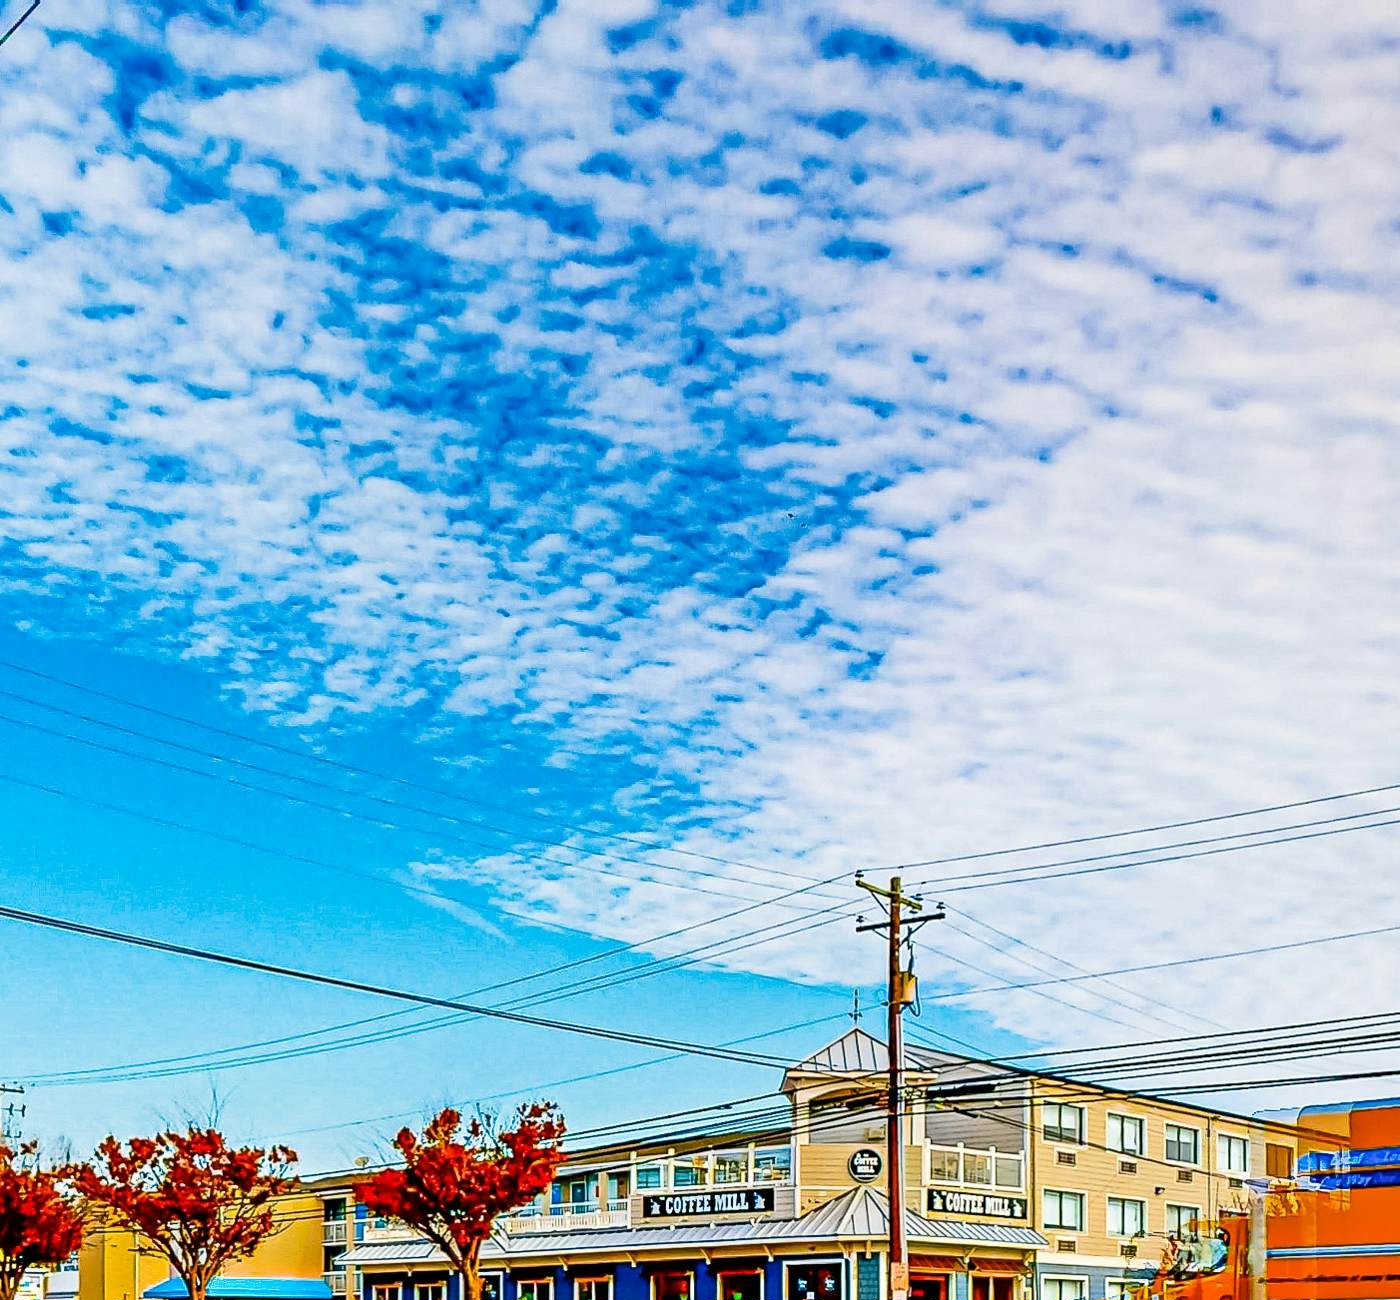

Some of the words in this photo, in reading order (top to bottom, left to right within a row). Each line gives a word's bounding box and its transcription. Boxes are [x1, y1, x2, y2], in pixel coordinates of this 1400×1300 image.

[854, 1156, 878, 1166] COFFEE
[857, 1165, 875, 1173] MILL
[665, 1195, 711, 1215] COFFEE
[714, 1193, 749, 1212] MILL
[945, 1192, 984, 1214] COFFEE
[984, 1196, 1011, 1216] MILL
